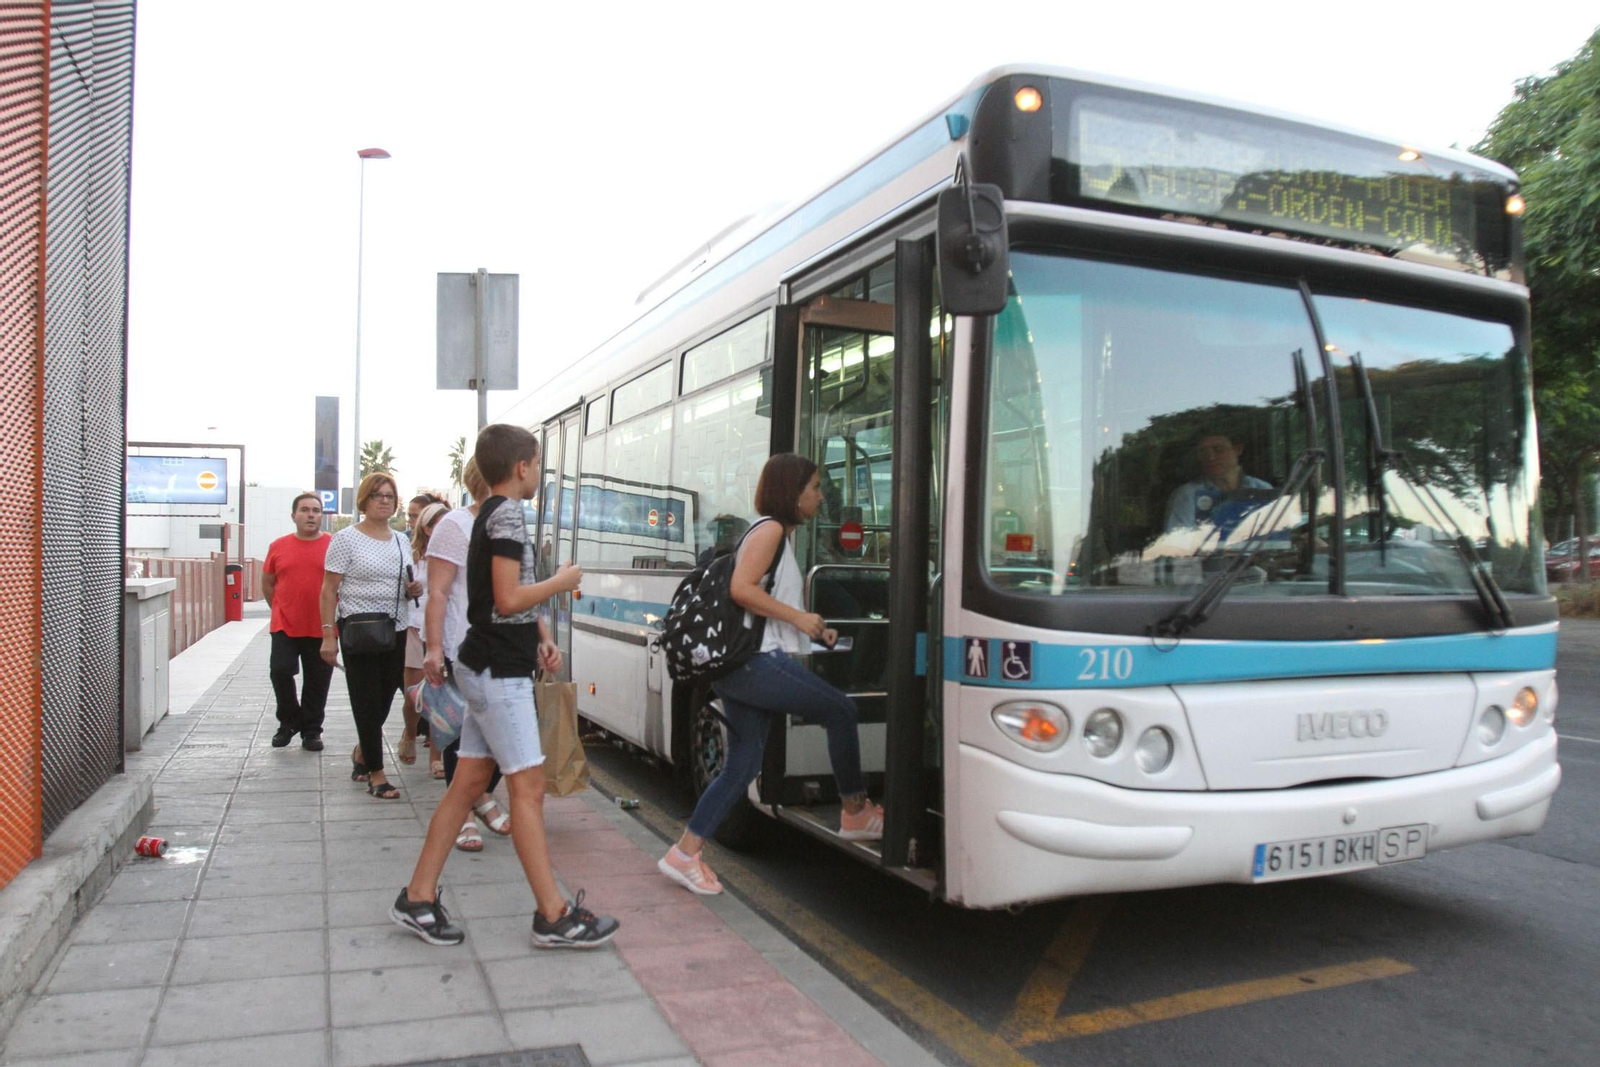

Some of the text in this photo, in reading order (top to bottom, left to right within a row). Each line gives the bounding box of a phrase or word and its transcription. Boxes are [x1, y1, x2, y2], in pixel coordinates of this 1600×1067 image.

[321, 491, 334, 507] P
[1077, 647, 1134, 680] 210
[1297, 708, 1389, 742] IVECO
[1268, 835, 1375, 872] 6151 BKH
[1385, 829, 1422, 859] SP
